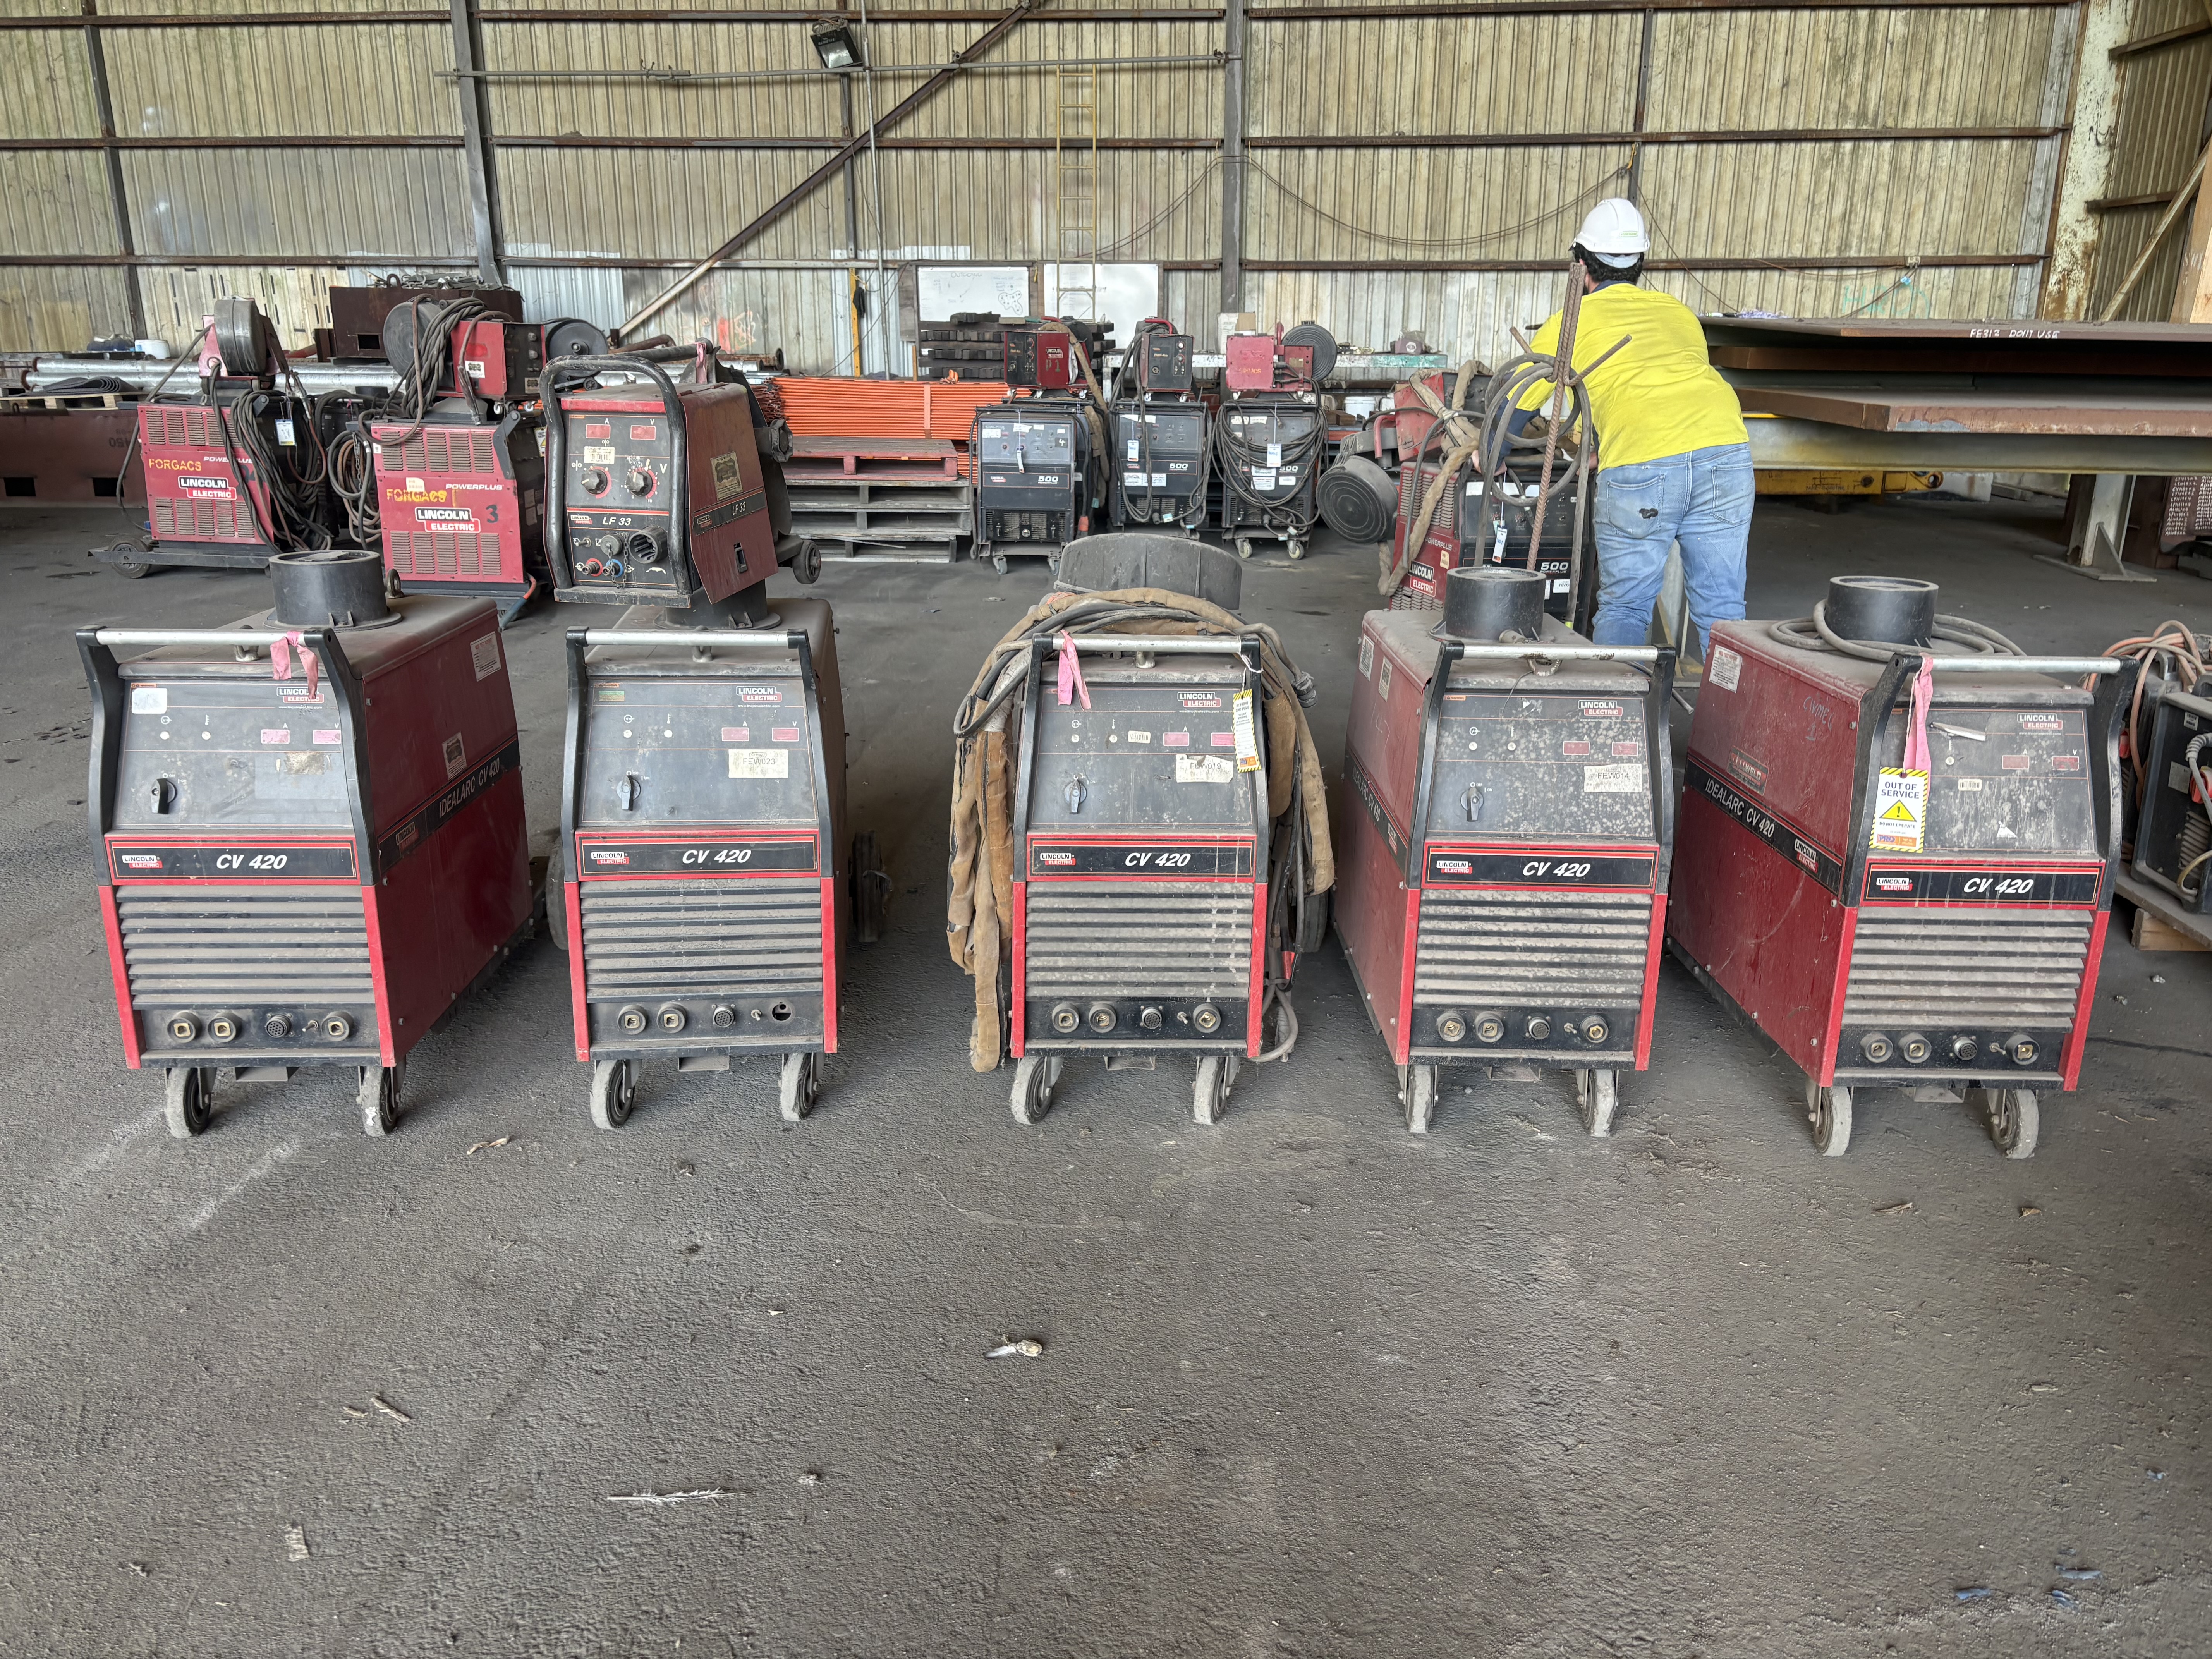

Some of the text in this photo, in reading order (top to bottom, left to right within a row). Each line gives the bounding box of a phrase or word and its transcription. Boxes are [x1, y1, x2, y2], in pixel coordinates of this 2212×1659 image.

[2037, 330, 2060, 339] USE
[148, 459, 201, 471] FORGACS
[659, 463, 667, 474] V
[181, 478, 226, 488] LINCOLN
[386, 489, 447, 502] FORGACS
[418, 510, 469, 520] LINCOLN
[485, 504, 498, 523] 3
[732, 501, 746, 515] LF 33
[618, 517, 632, 526] 33
[1408, 563, 1432, 580] LINCOLN
[1540, 562, 1569, 570] 500
[1413, 579, 1434, 594] ELECTRIC
[440, 757, 500, 818] IDEALARC CV 420
[1885, 781, 1903, 790] OUT
[1881, 789, 1920, 799] SERVICE
[1705, 778, 1774, 838] IDEALARC CV 420
[682, 850, 752, 864] CV 420
[1796, 839, 1815, 861] LINCOLN
[216, 854, 287, 869] CV 420
[1125, 852, 1191, 867] CV 420
[1799, 854, 1816, 871] ELECTRIC
[1523, 862, 1591, 877] CV 420
[1964, 878, 2034, 893] CV 420
